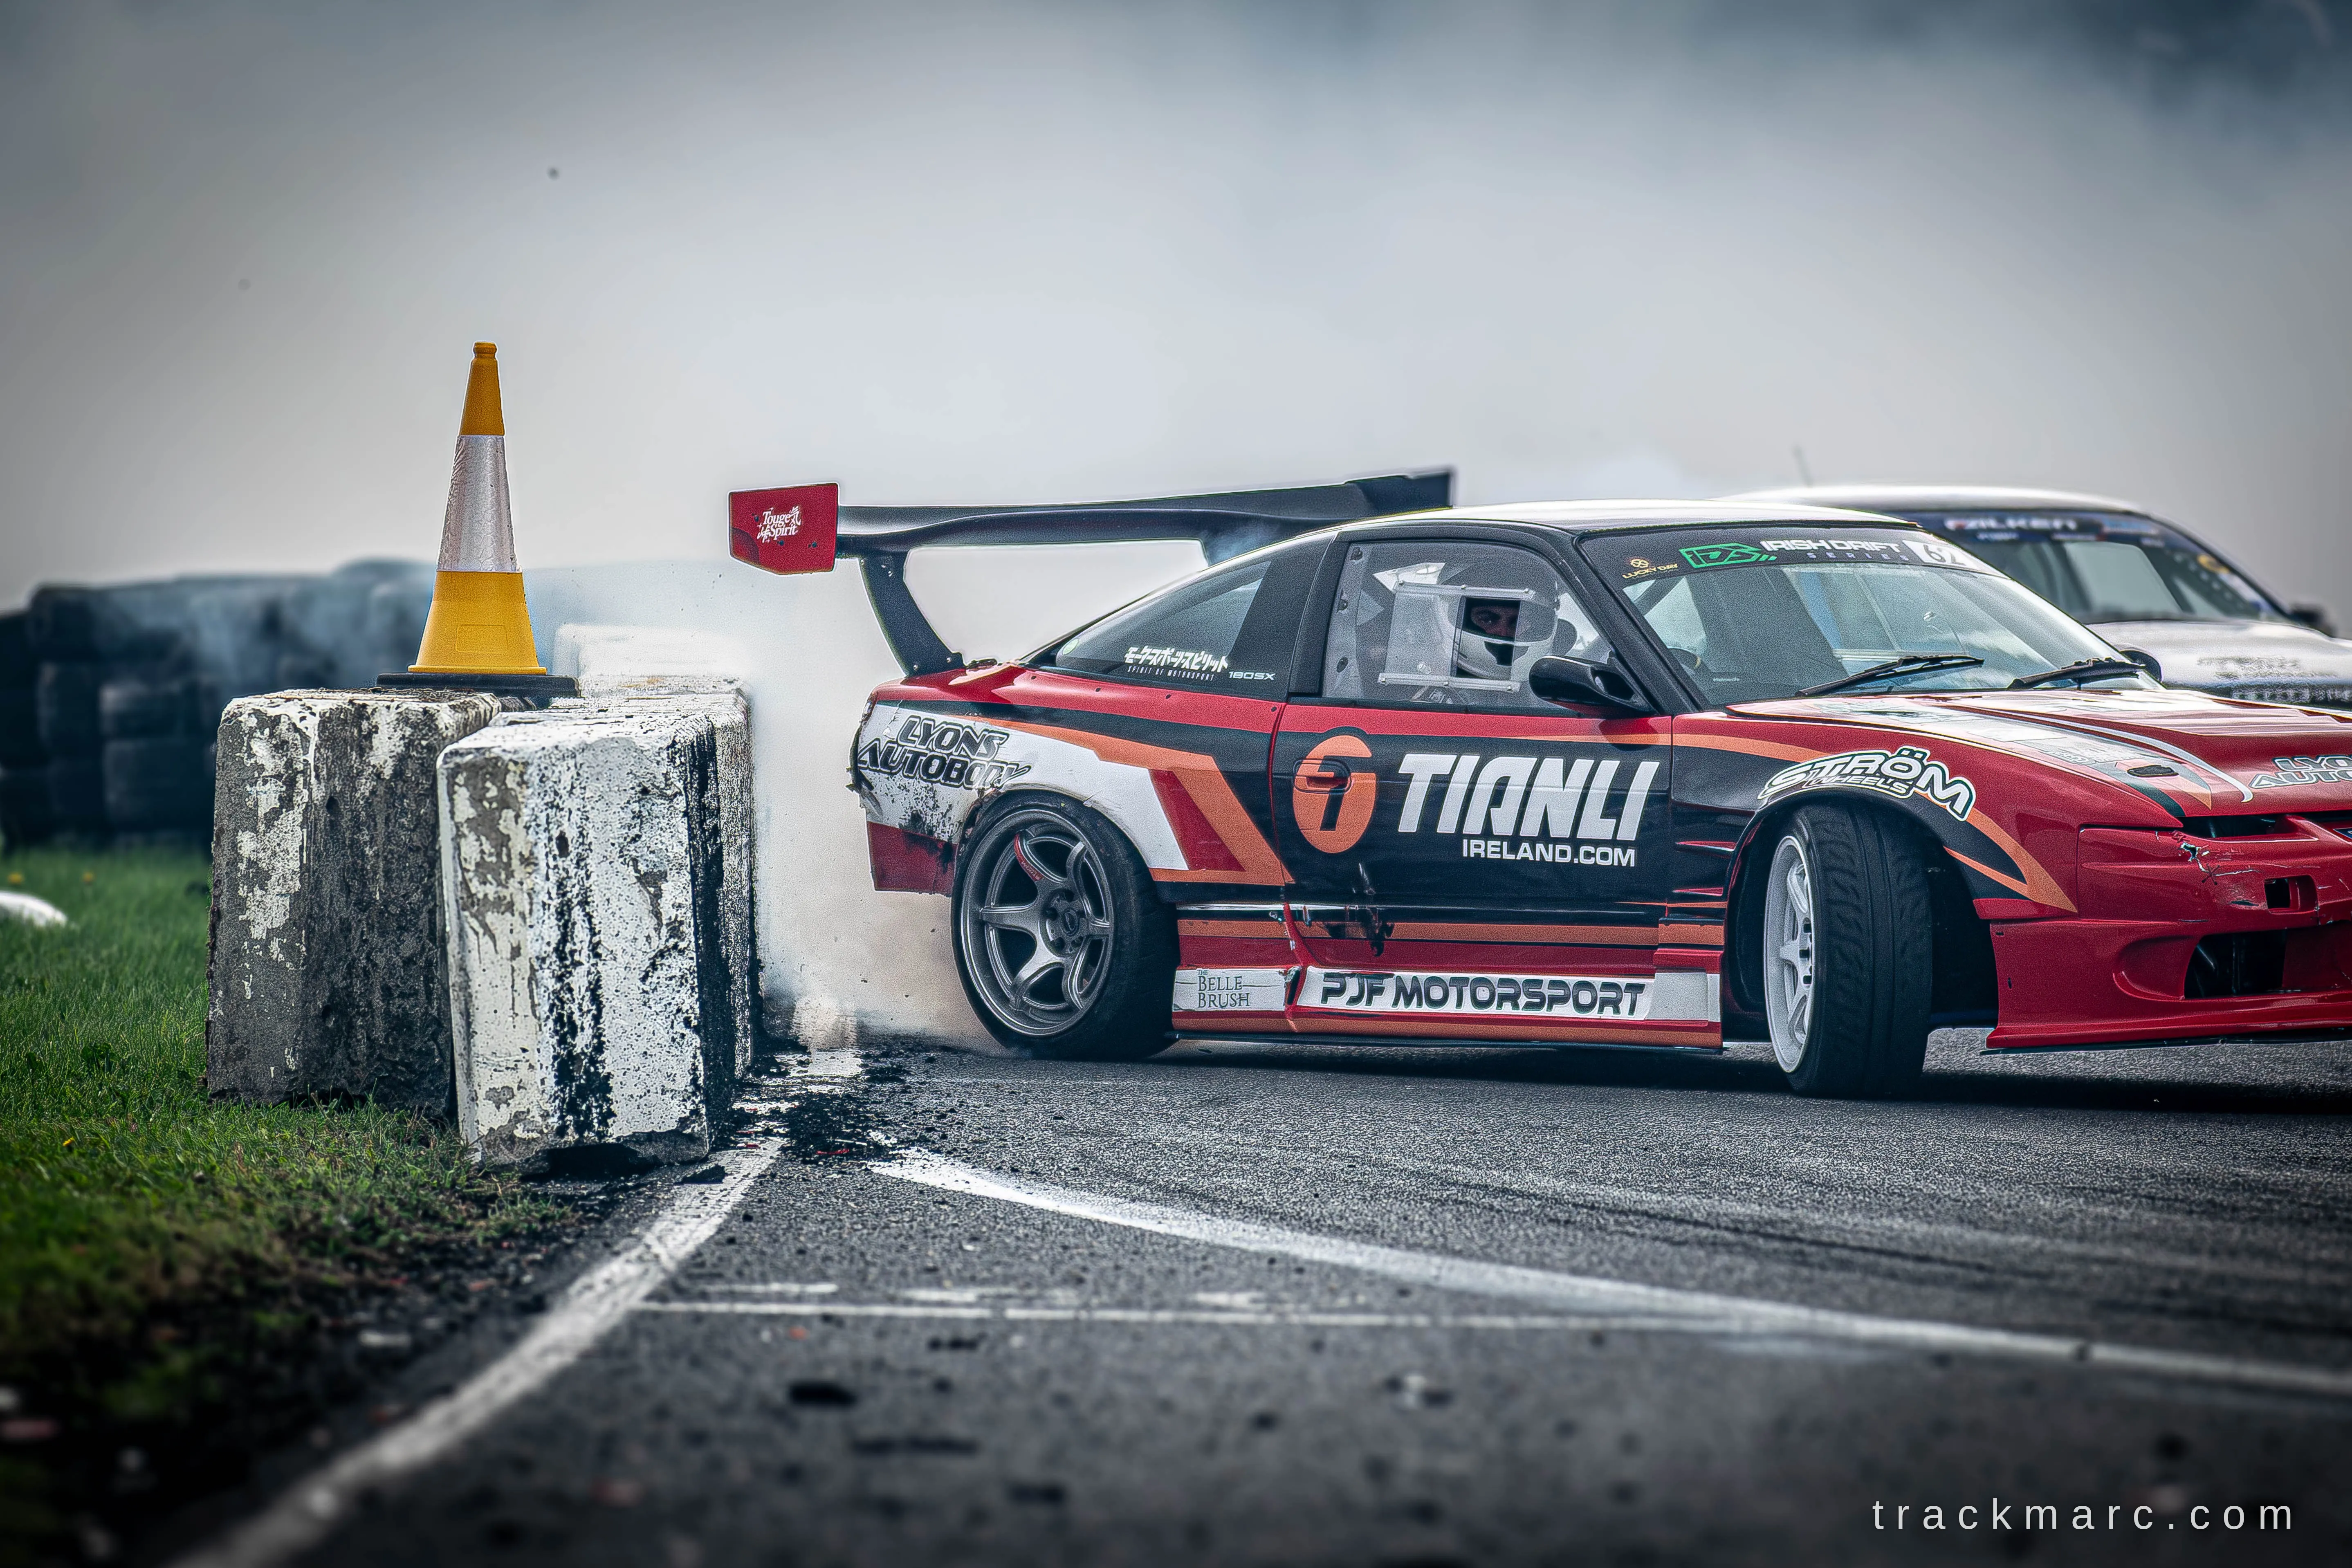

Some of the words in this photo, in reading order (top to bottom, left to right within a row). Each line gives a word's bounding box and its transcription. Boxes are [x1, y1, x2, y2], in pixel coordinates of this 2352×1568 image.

[762, 509, 790, 527] Touge
[770, 524, 798, 540] Spirit
[1760, 540, 1832, 551] IRISH
[1829, 540, 1901, 552] DRIFT
[1127, 665, 1152, 674] SPIRIT
[1167, 670, 1214, 681] MOTORSPORT
[1228, 671, 1276, 681] 180SX
[897, 715, 1010, 760] LYONS
[858, 738, 1031, 790] AUTOBODY
[1759, 747, 1975, 818] STRÖM
[1398, 754, 1660, 841] TIANLI
[1463, 839, 1635, 867] IRELAND.COM
[1198, 976, 1242, 991] BELLE
[1198, 992, 1250, 1008] BRUSH
[1321, 973, 1386, 1006] PJF
[1391, 976, 1646, 1016] MOTORSPORT
